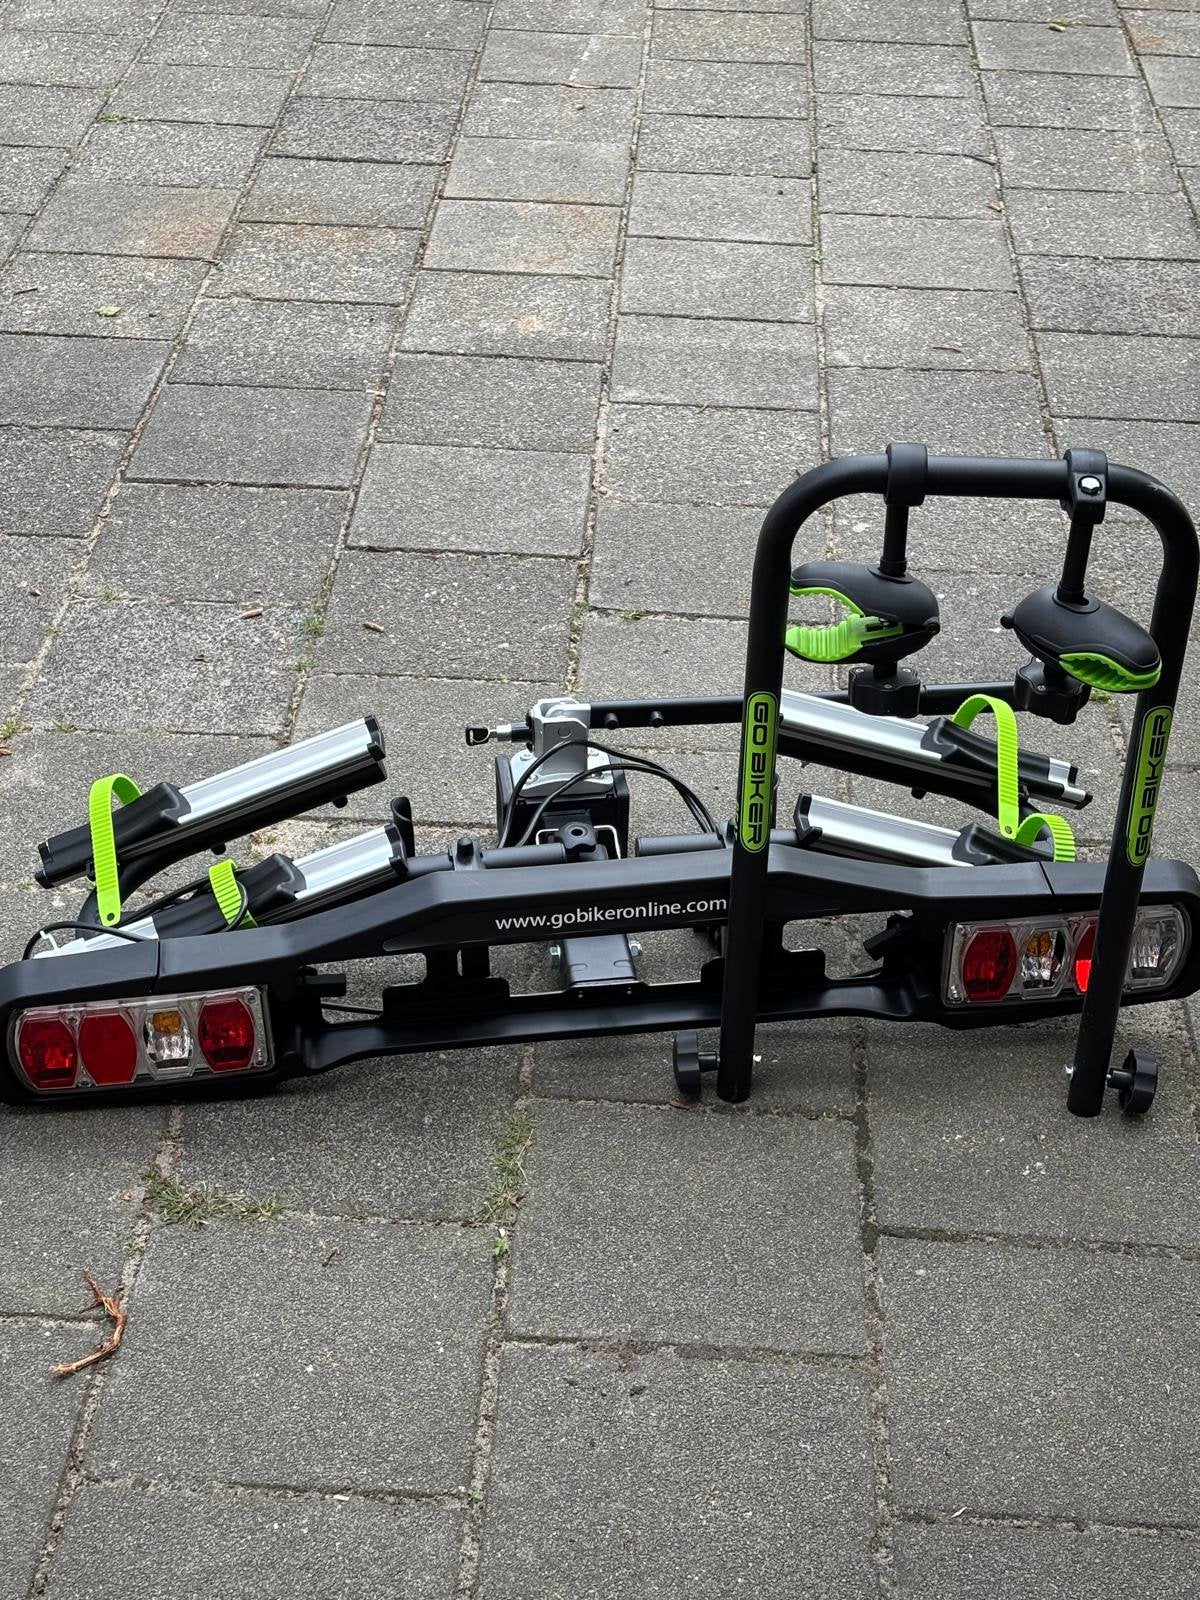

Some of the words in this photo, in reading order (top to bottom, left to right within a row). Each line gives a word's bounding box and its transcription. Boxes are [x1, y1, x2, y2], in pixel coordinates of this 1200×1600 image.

[752, 702, 769, 746] GO
[1141, 716, 1167, 808] BIKER
[748, 752, 767, 845] BIKER
[1135, 814, 1153, 857] GO
[495, 898, 727, 930] www.gobikeronline.com
